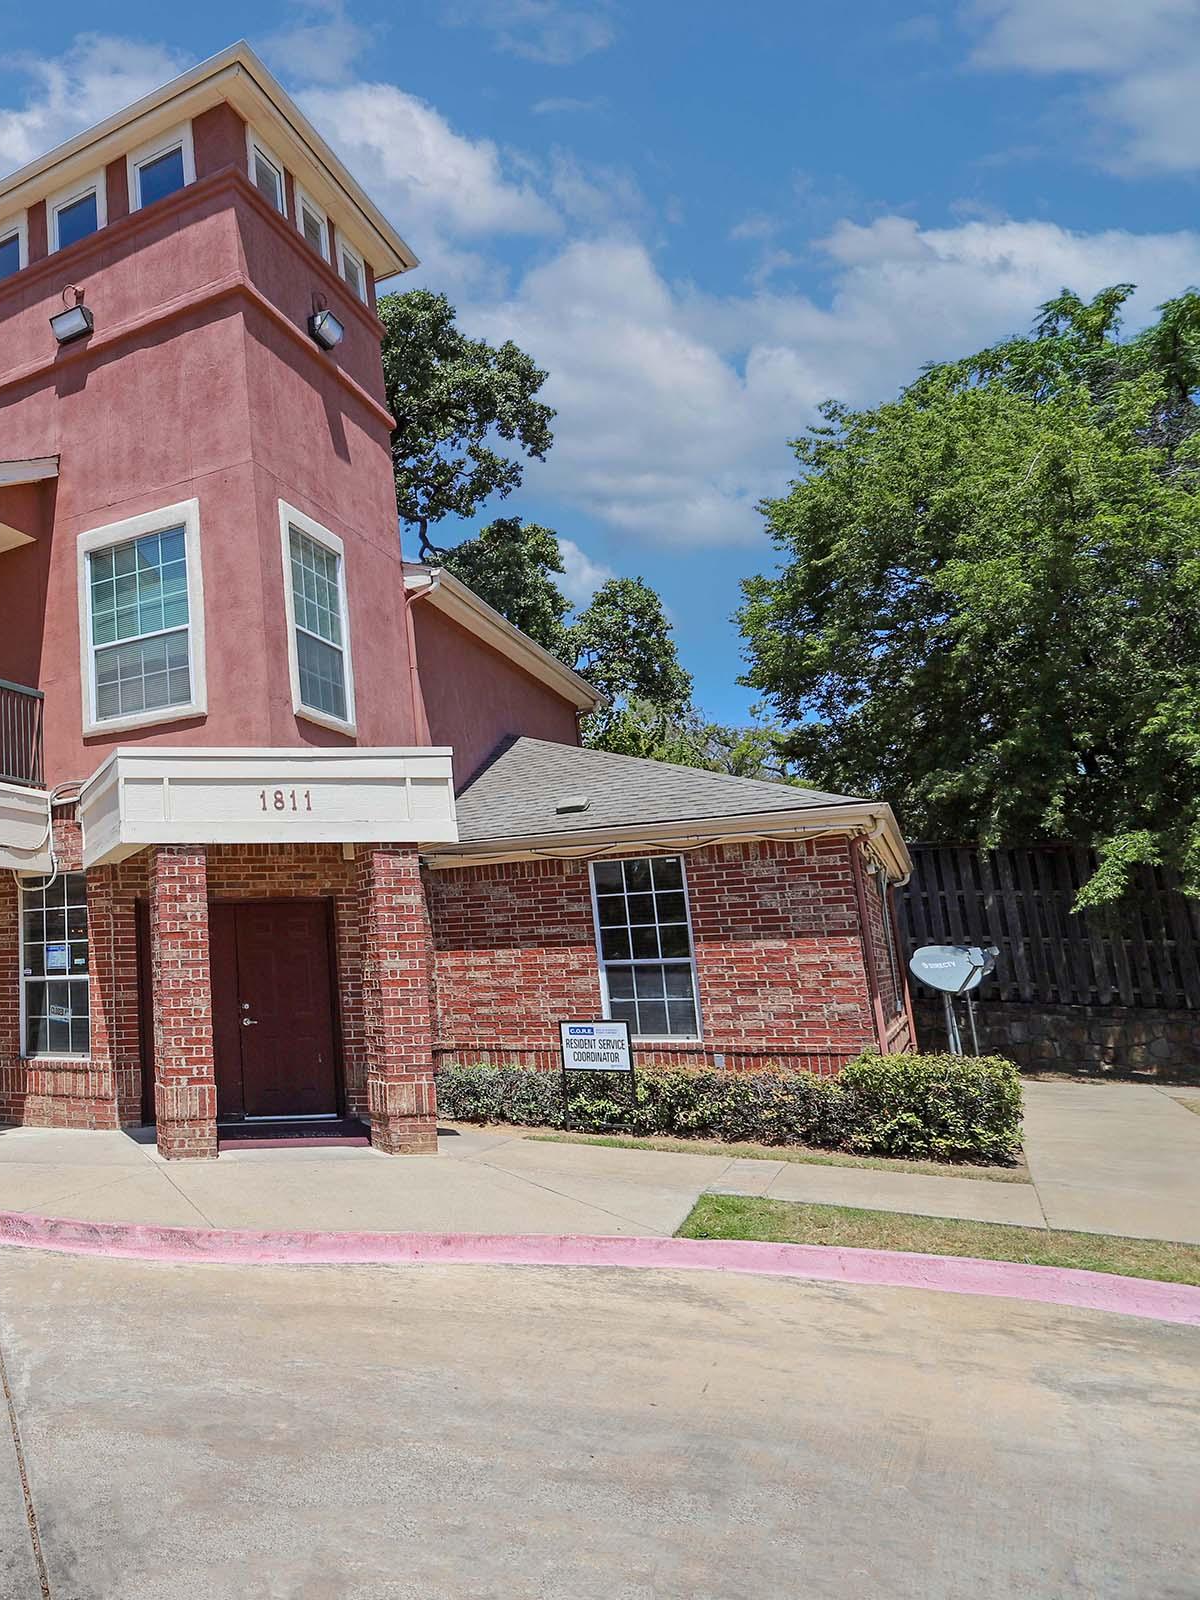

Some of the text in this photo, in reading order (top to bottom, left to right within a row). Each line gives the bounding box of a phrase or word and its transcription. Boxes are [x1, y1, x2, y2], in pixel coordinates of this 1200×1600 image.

[260, 790, 311, 810] 1811
[566, 1039, 625, 1050] RESIDENT SERVICE
[573, 1052, 620, 1062] COORDINATOR
